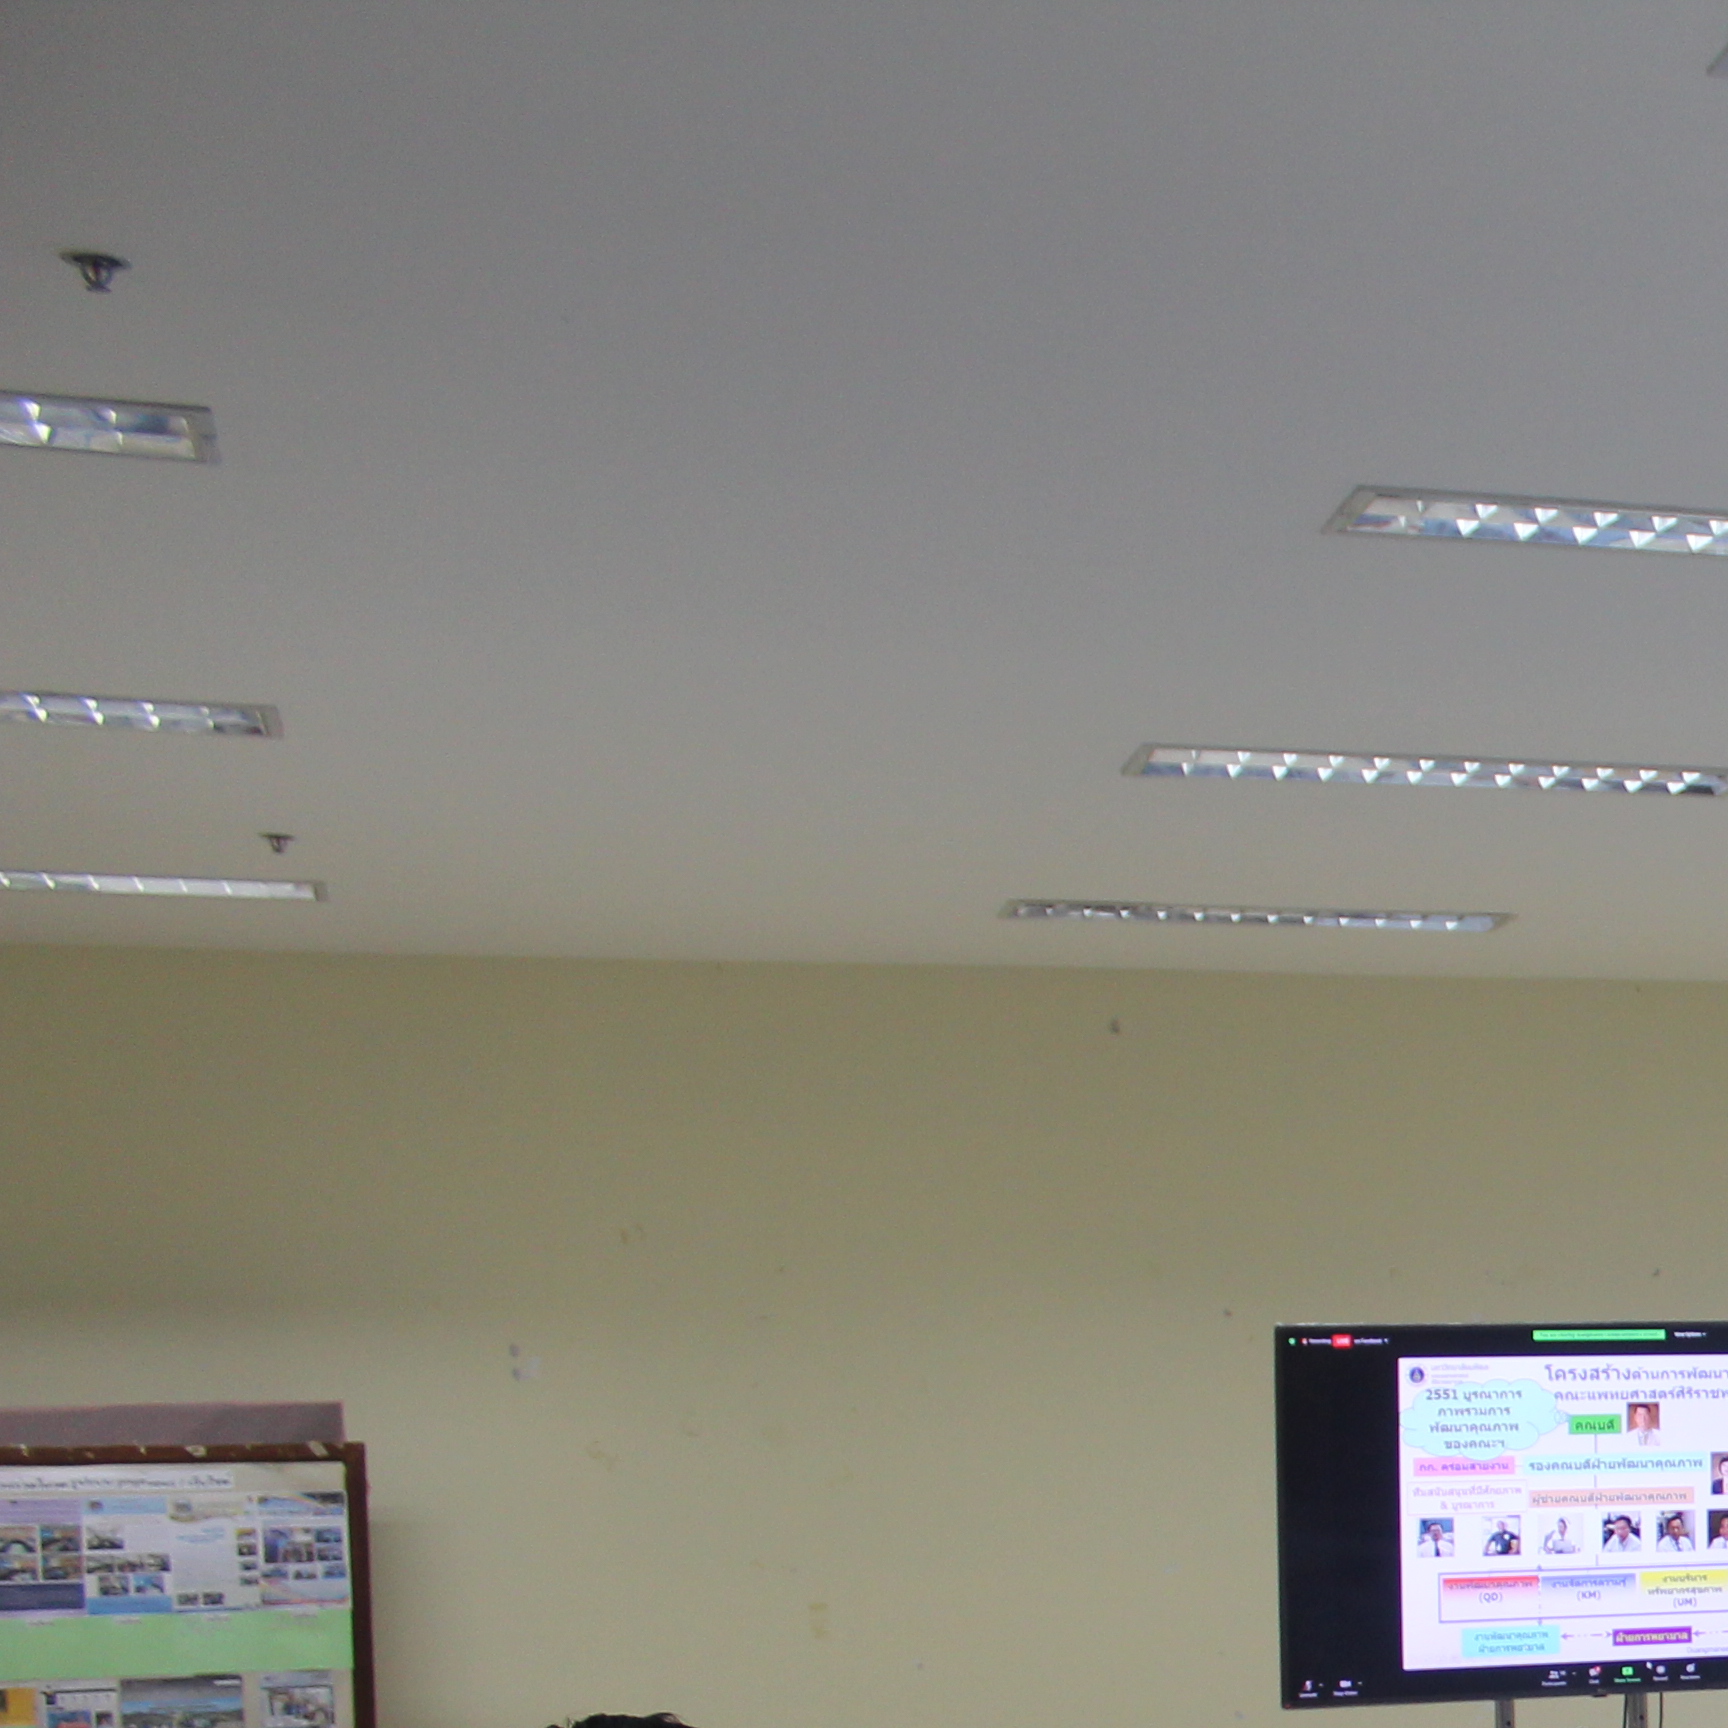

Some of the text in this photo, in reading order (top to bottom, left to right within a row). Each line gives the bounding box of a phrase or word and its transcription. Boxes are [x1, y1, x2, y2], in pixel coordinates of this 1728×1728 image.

[1425, 1389, 1523, 1403] 2551 บูรณาการ
[1437, 1406, 1511, 1417] ภาพรวมการ
[1429, 1422, 1519, 1434] พัฒนาคุณภาพ
[1575, 1417, 1616, 1431] คณบดี
[1576, 1590, 1601, 1601] (KM)
